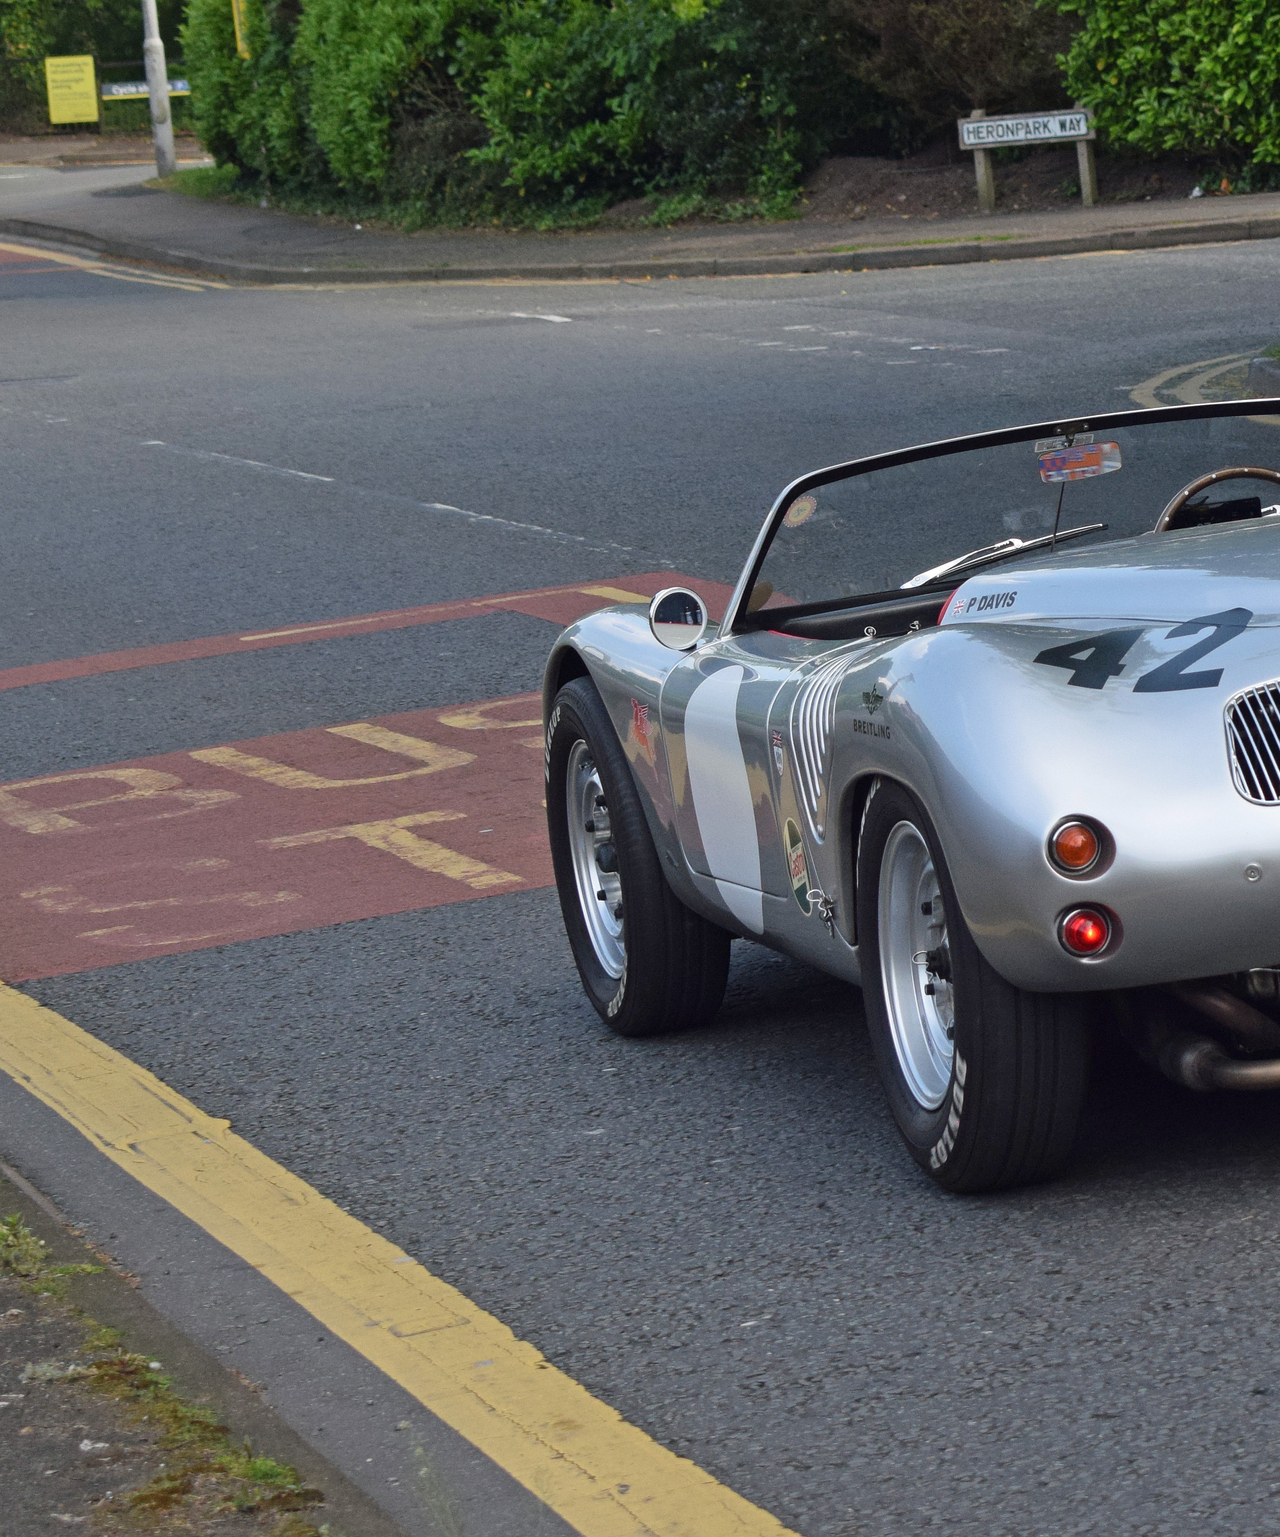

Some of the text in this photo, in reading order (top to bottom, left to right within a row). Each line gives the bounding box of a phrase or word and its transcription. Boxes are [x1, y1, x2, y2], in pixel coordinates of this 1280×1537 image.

[966, 117, 1083, 140] HERONPARK WAY
[966, 591, 1018, 613] P DAVIS
[1033, 607, 1254, 693] 42
[853, 719, 891, 740] BREITLING
